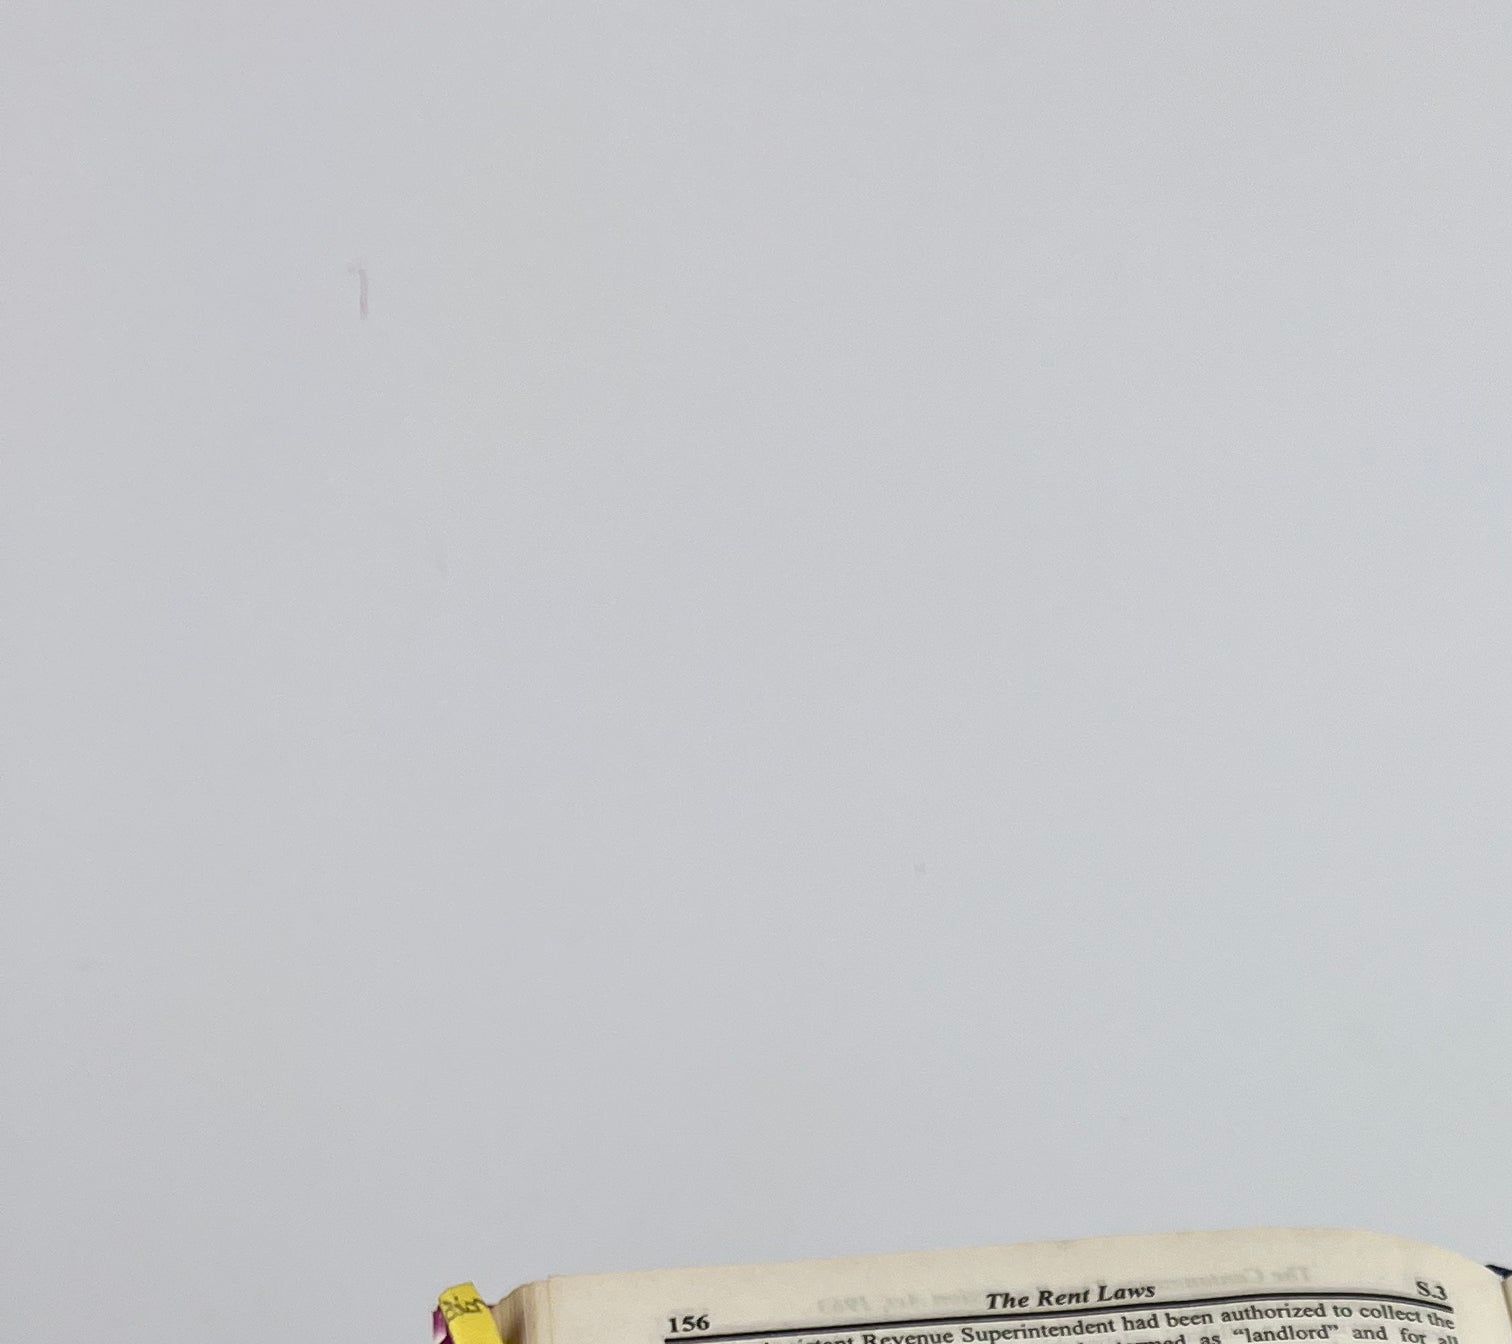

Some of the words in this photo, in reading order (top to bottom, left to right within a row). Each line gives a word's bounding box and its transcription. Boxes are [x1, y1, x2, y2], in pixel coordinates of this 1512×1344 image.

[986, 1293, 1029, 1310] The
[1037, 1289, 1090, 1307] Rent
[1097, 1285, 1155, 1302] Laws
[1416, 1281, 1447, 1300] S.3
[669, 1314, 710, 1333] 156
[961, 1320, 1116, 1344] Superintendent
[1121, 1314, 1159, 1331] had
[1165, 1313, 1213, 1327] been
[1221, 1303, 1326, 1322] authorized
[1332, 1305, 1352, 1317] to
[1359, 1304, 1422, 1323] collect
[1427, 1313, 1455, 1329] the
